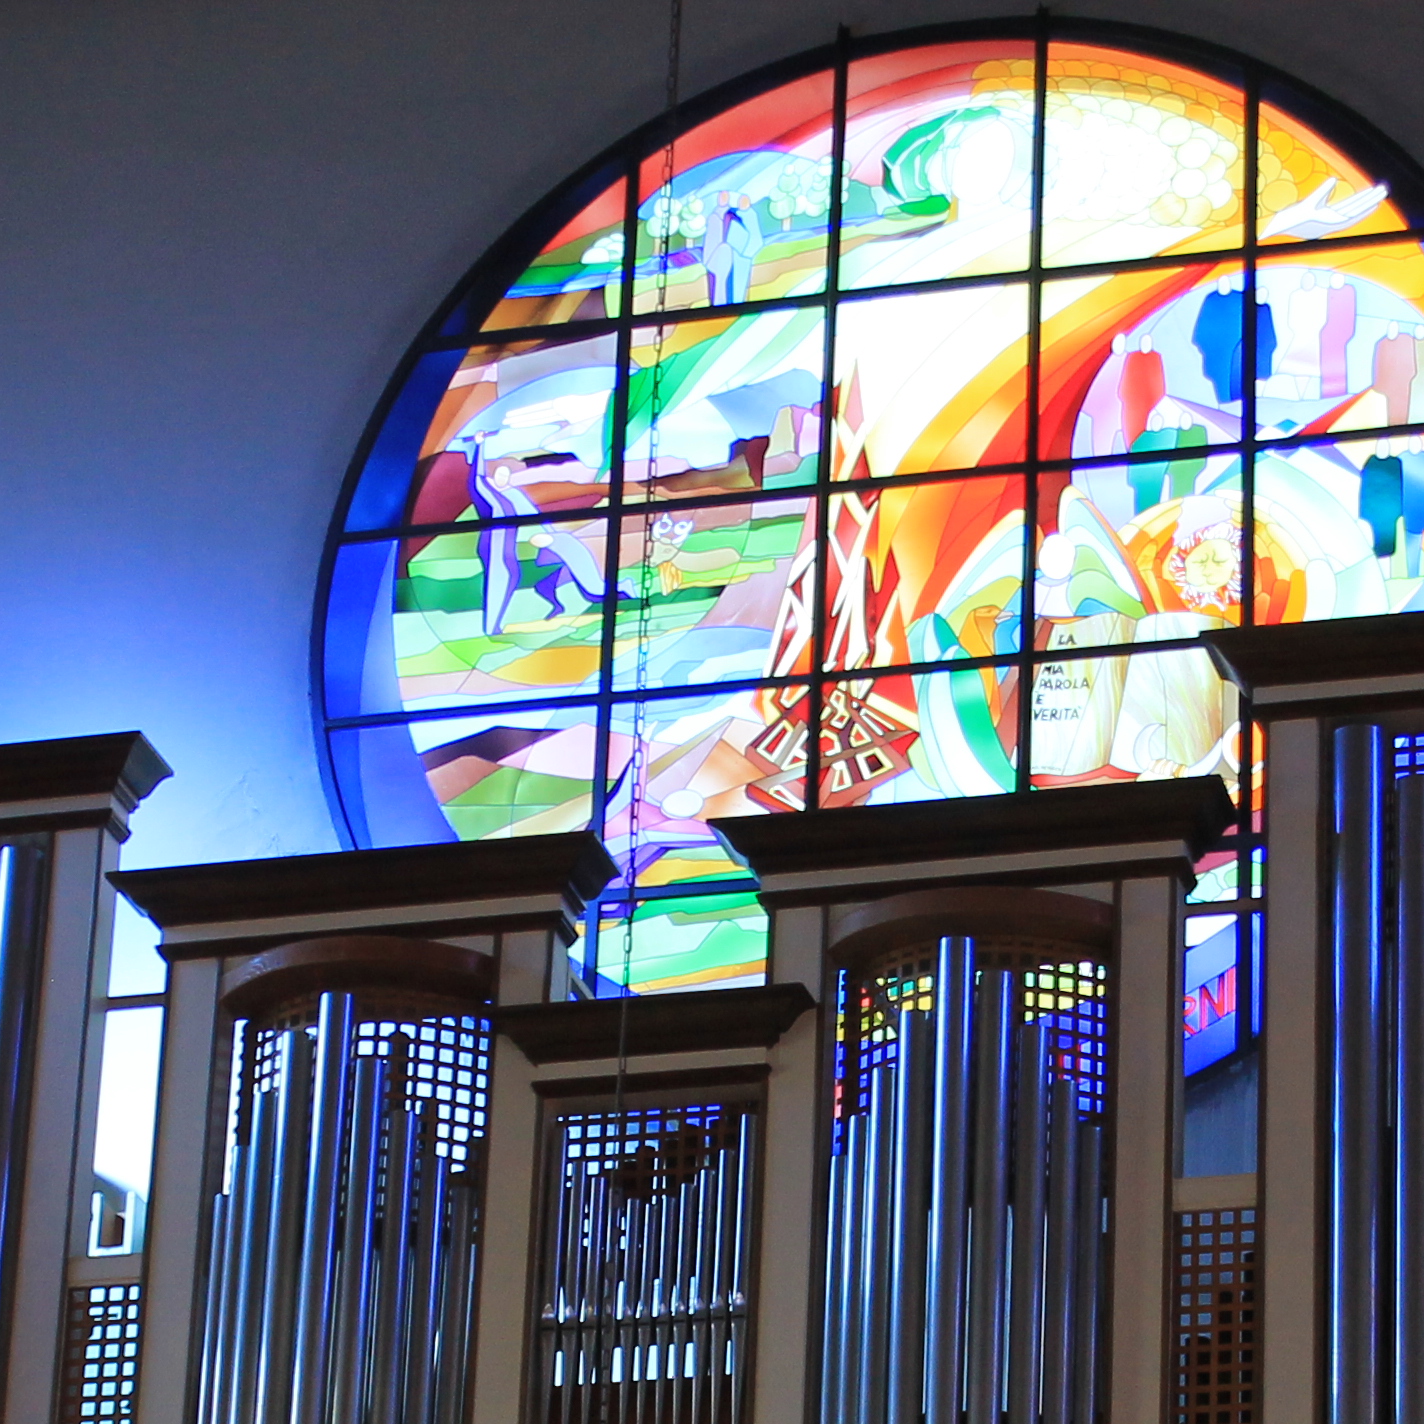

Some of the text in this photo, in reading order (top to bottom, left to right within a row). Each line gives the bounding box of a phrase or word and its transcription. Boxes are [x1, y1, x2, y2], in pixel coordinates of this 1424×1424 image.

[1057, 633, 1077, 646] LA
[1041, 664, 1064, 675] MIA
[1039, 677, 1091, 690] PAROLA
